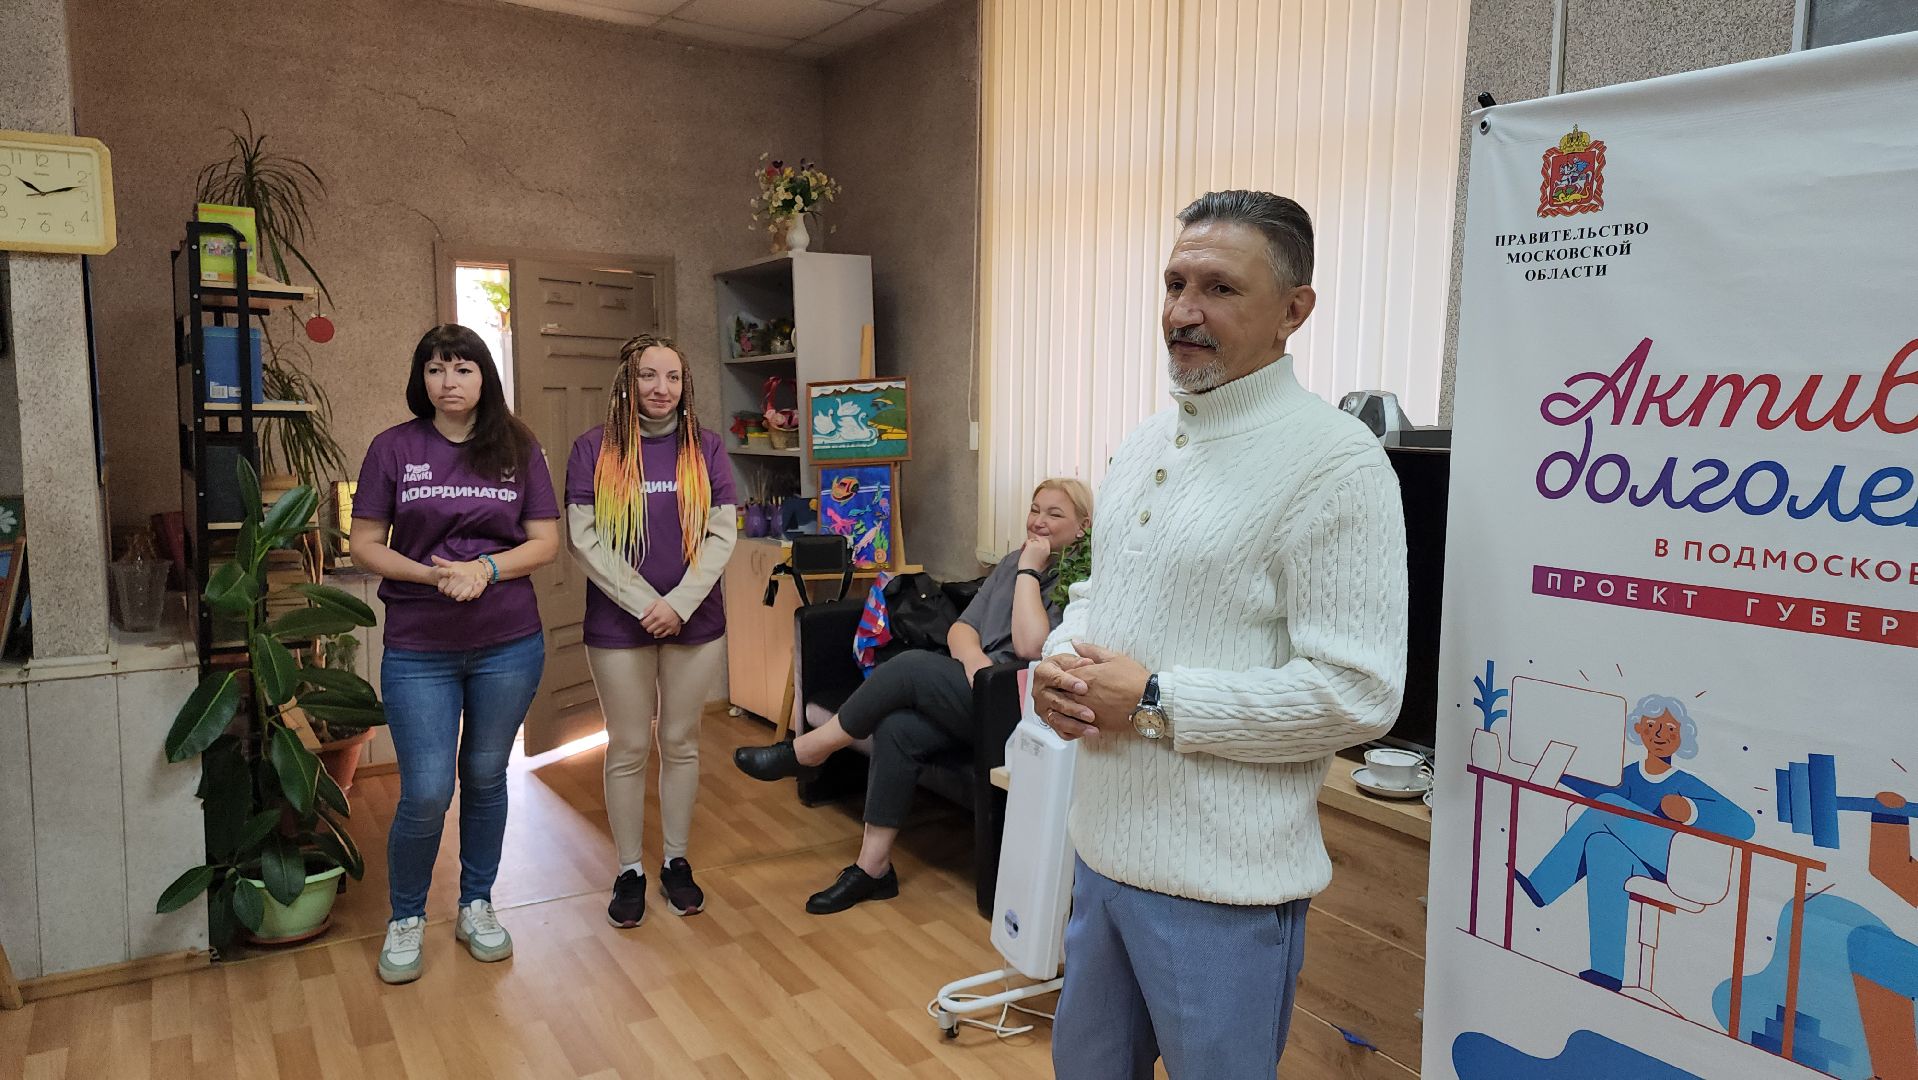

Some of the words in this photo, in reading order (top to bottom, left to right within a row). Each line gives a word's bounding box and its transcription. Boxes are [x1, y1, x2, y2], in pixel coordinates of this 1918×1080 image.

[11, 151, 22, 165] 11
[35, 152, 49, 167] 12
[77, 170, 89, 184] 2
[18, 217, 27, 231] 7
[80, 210, 89, 223] 4
[40, 219, 51, 233] 6
[64, 220, 75, 234] 5
[1495, 221, 1649, 246] ПРАВИТЕЛЬСТВО
[1506, 240, 1633, 265] МОСКОВСКОЙ
[1524, 263, 1608, 282] ОБЛАСТИ
[1536, 415, 1918, 527] долголе
[401, 485, 517, 503] КООРДИНАТОР
[1654, 537, 1669, 558] В
[1546, 571, 1698, 609] ПРОЕКТ
